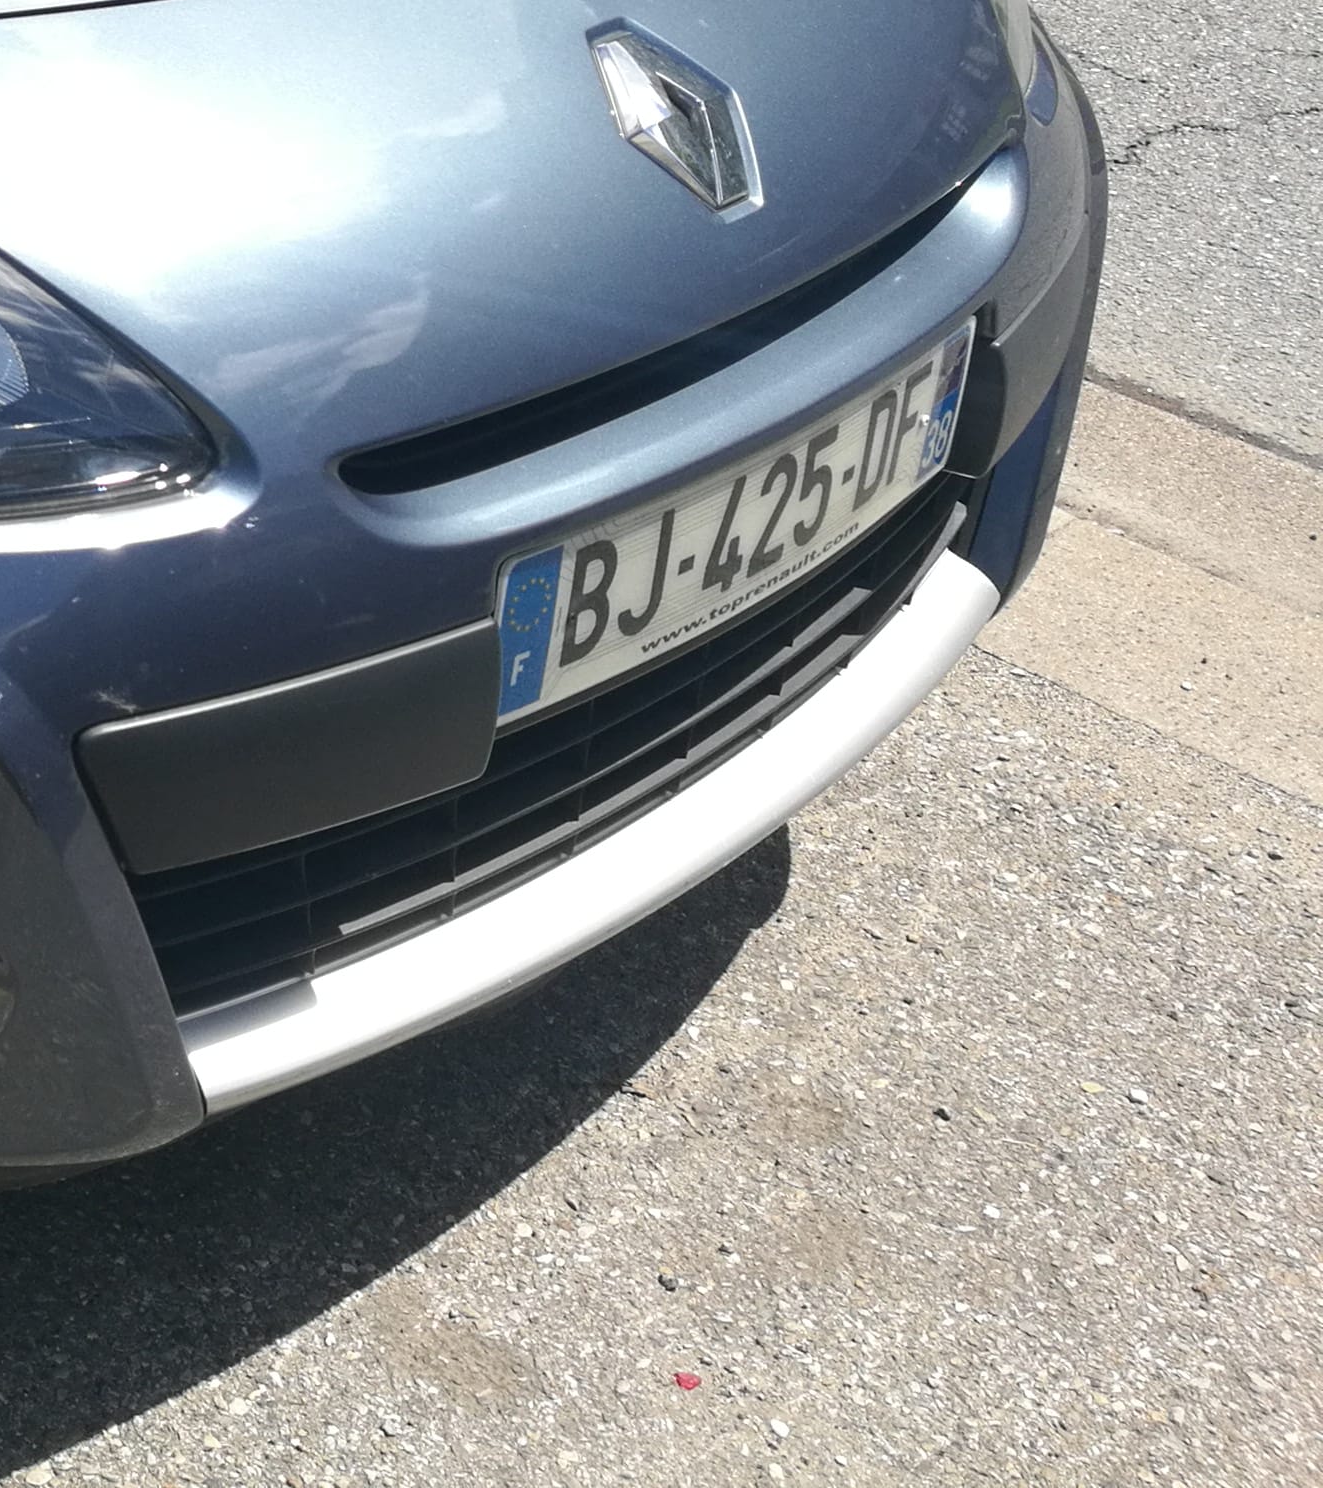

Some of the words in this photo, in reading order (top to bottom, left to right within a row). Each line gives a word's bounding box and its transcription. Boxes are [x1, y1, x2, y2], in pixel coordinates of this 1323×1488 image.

[922, 410, 953, 466] 38
[559, 360, 934, 668] BJ-425-DF
[640, 522, 860, 654] www.toprenault.com
[510, 650, 532, 687] F
